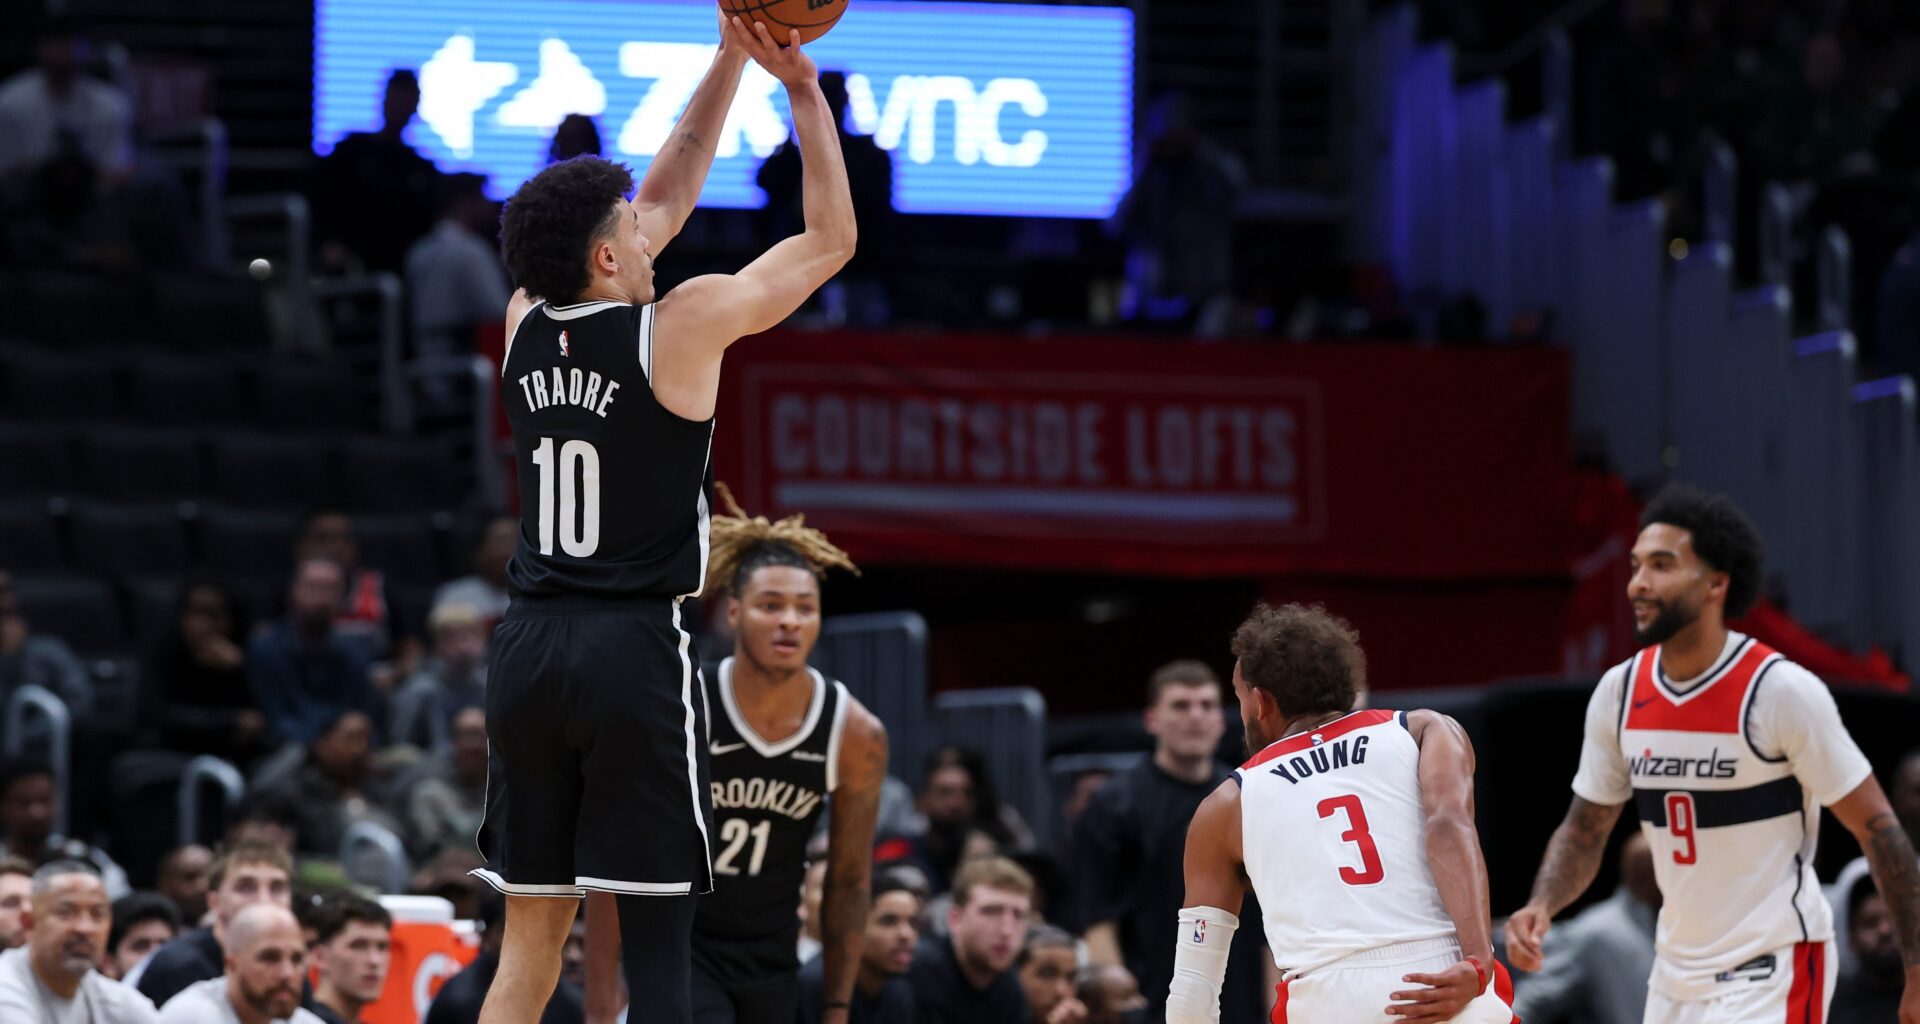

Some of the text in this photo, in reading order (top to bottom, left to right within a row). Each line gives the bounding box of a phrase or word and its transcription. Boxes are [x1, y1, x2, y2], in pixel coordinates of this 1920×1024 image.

[617, 41, 1048, 167] ZKync
[519, 367, 620, 418] TRAORE
[770, 393, 1298, 487] COURTSIDE LOFTS
[532, 437, 600, 558] 10
[1270, 735, 1369, 785] YOUNG
[1627, 747, 1737, 778] wizards
[711, 777, 821, 820] ROOKLYN
[1664, 791, 1697, 866] 9
[714, 818, 772, 876] 21
[1316, 794, 1385, 885] 3
